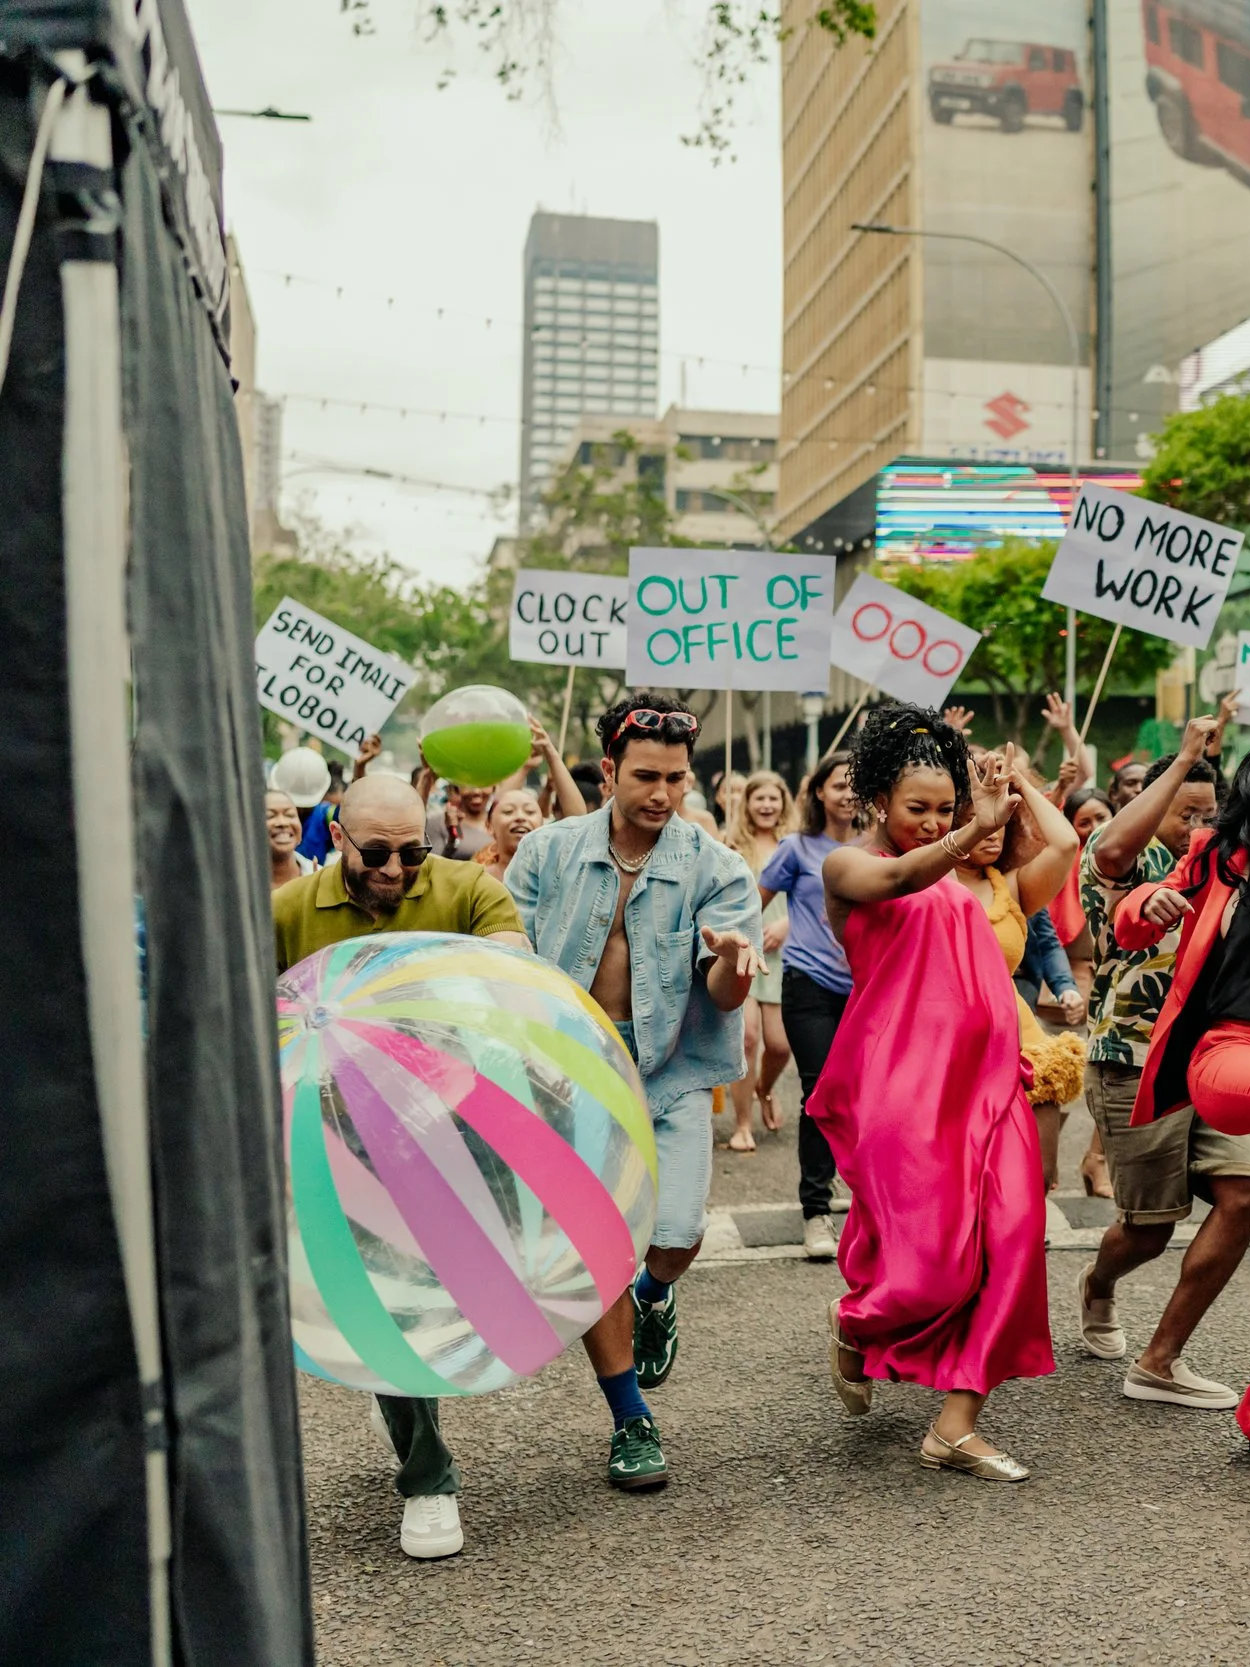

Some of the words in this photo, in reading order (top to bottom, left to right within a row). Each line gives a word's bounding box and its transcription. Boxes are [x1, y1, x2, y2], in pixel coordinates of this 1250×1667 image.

[1073, 496, 1125, 542] NO
[1135, 516, 1237, 578] MORE
[517, 591, 628, 624] CLOCK
[637, 575, 740, 616] OUT
[766, 574, 824, 611] OF
[1096, 558, 1216, 628] WORK
[273, 611, 334, 655] SEND
[335, 647, 406, 702] IMALI
[538, 630, 610, 657] OUT
[647, 617, 799, 665] OFFICE
[852, 602, 963, 677] OOO
[289, 655, 345, 697] FOR
